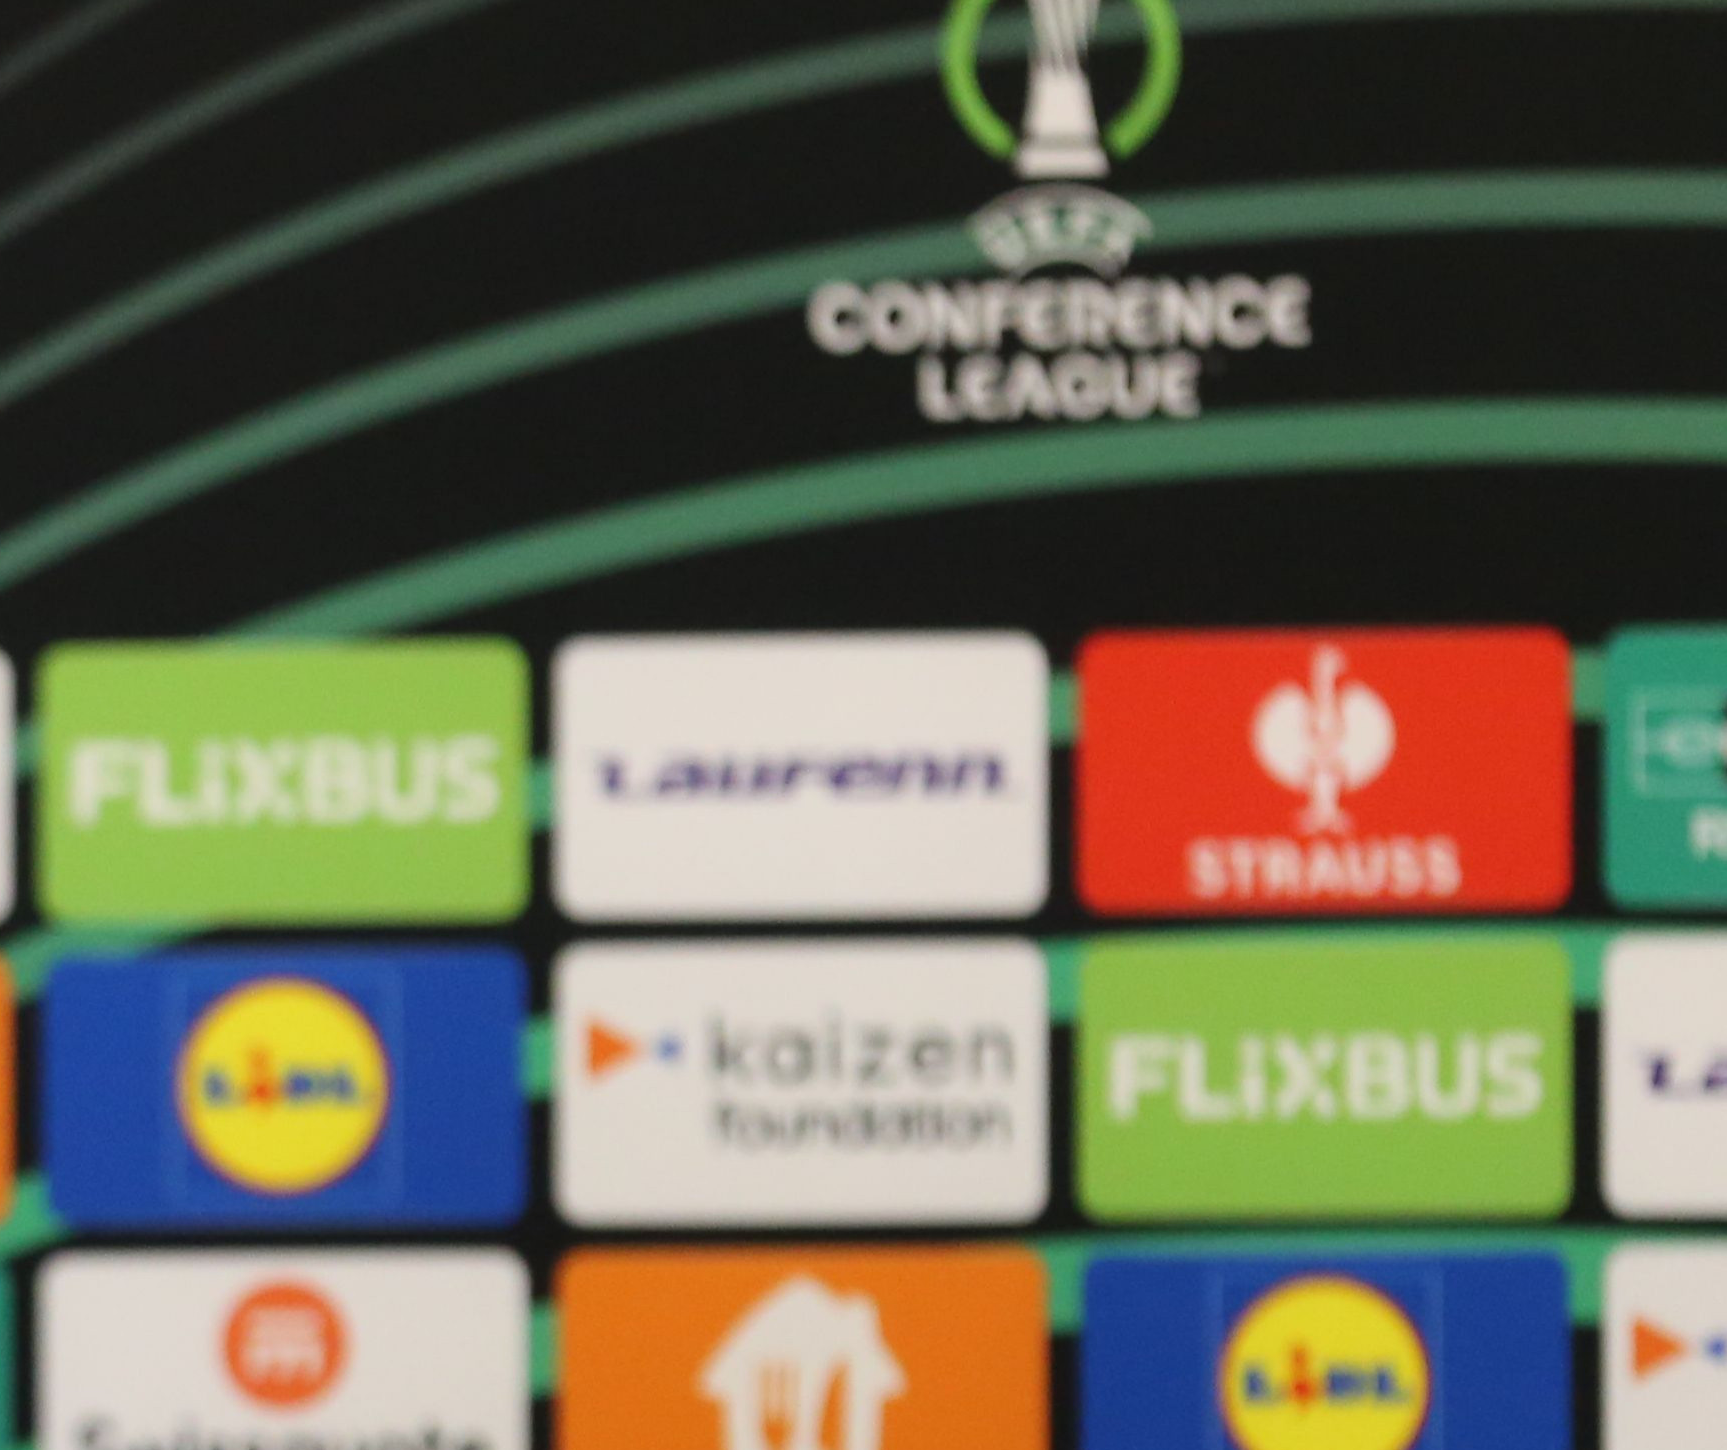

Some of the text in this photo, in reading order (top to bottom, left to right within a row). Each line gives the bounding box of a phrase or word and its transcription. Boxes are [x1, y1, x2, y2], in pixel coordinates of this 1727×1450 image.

[807, 276, 1313, 355] CONFERENCE
[917, 354, 1200, 423] LEAGUE
[600, 753, 1006, 797] Laurenn
[1190, 839, 1460, 896] STRAUSS
[707, 1014, 1016, 1083] kaizen
[711, 1101, 1011, 1147] foundation
